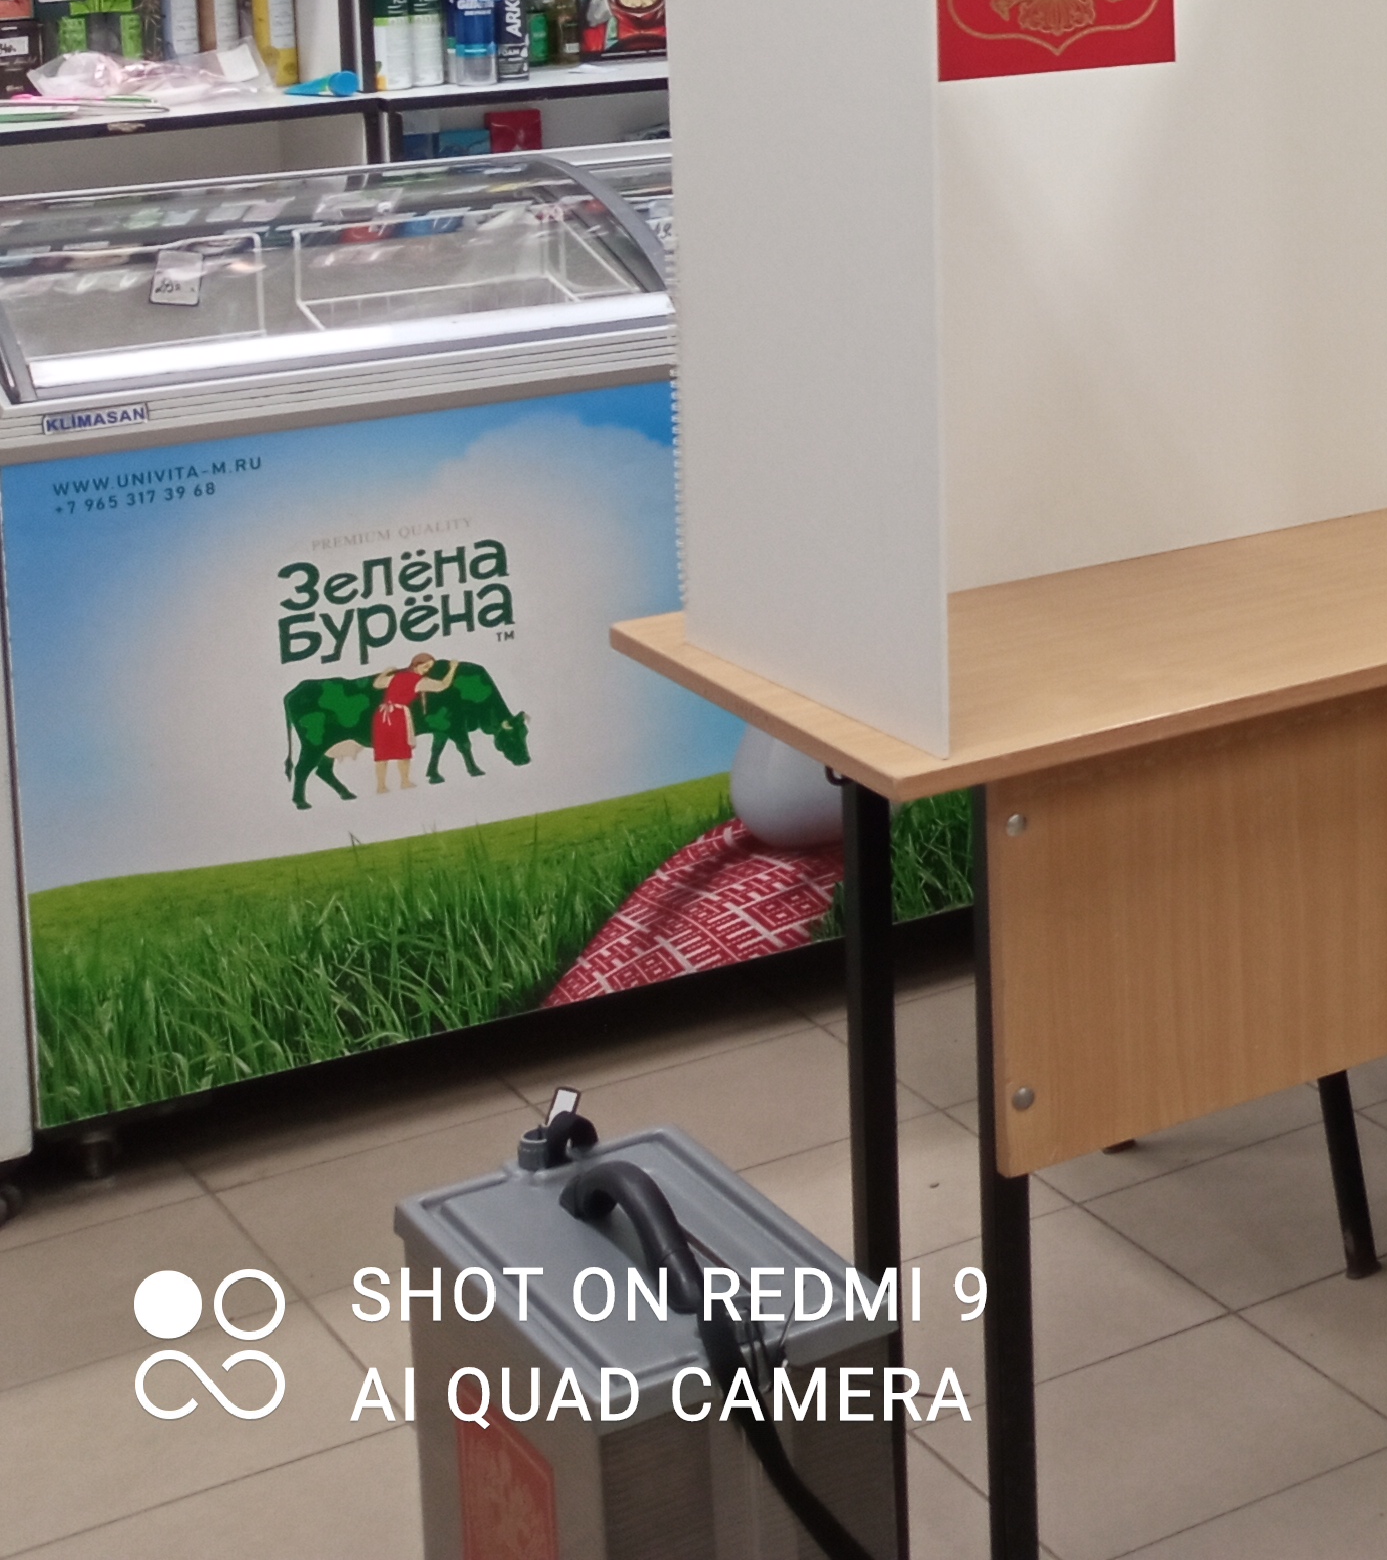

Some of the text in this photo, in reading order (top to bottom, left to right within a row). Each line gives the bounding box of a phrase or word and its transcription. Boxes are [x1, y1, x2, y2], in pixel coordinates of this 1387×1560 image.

[52, 456, 264, 497] WWW.UNIVITA-M.RU
[55, 480, 217, 516] +7 965 317 39 68
[310, 516, 474, 553] PREMIUM QUALITY
[277, 539, 510, 610] Зелёна
[279, 583, 516, 665] Бурёна
